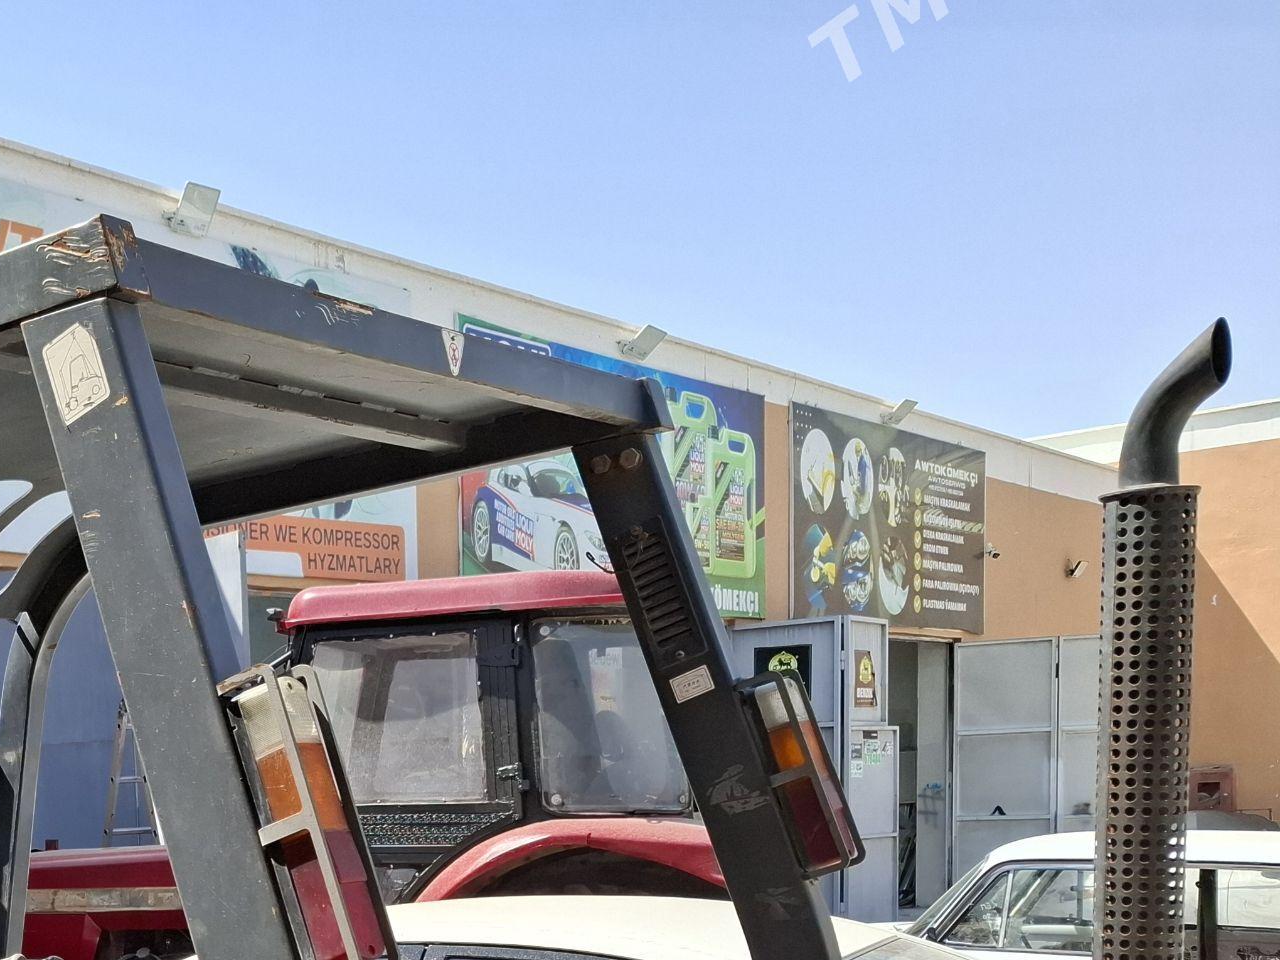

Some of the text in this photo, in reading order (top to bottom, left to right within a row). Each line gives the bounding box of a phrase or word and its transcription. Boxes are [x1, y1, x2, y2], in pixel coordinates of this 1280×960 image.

[914, 459, 978, 487] AWTOKÖMEKÇI
[274, 525, 298, 543] WE
[302, 527, 400, 551] KOMPRESSOR
[514, 528, 534, 552] MOLY
[308, 553, 401, 574] HYZMATLARY
